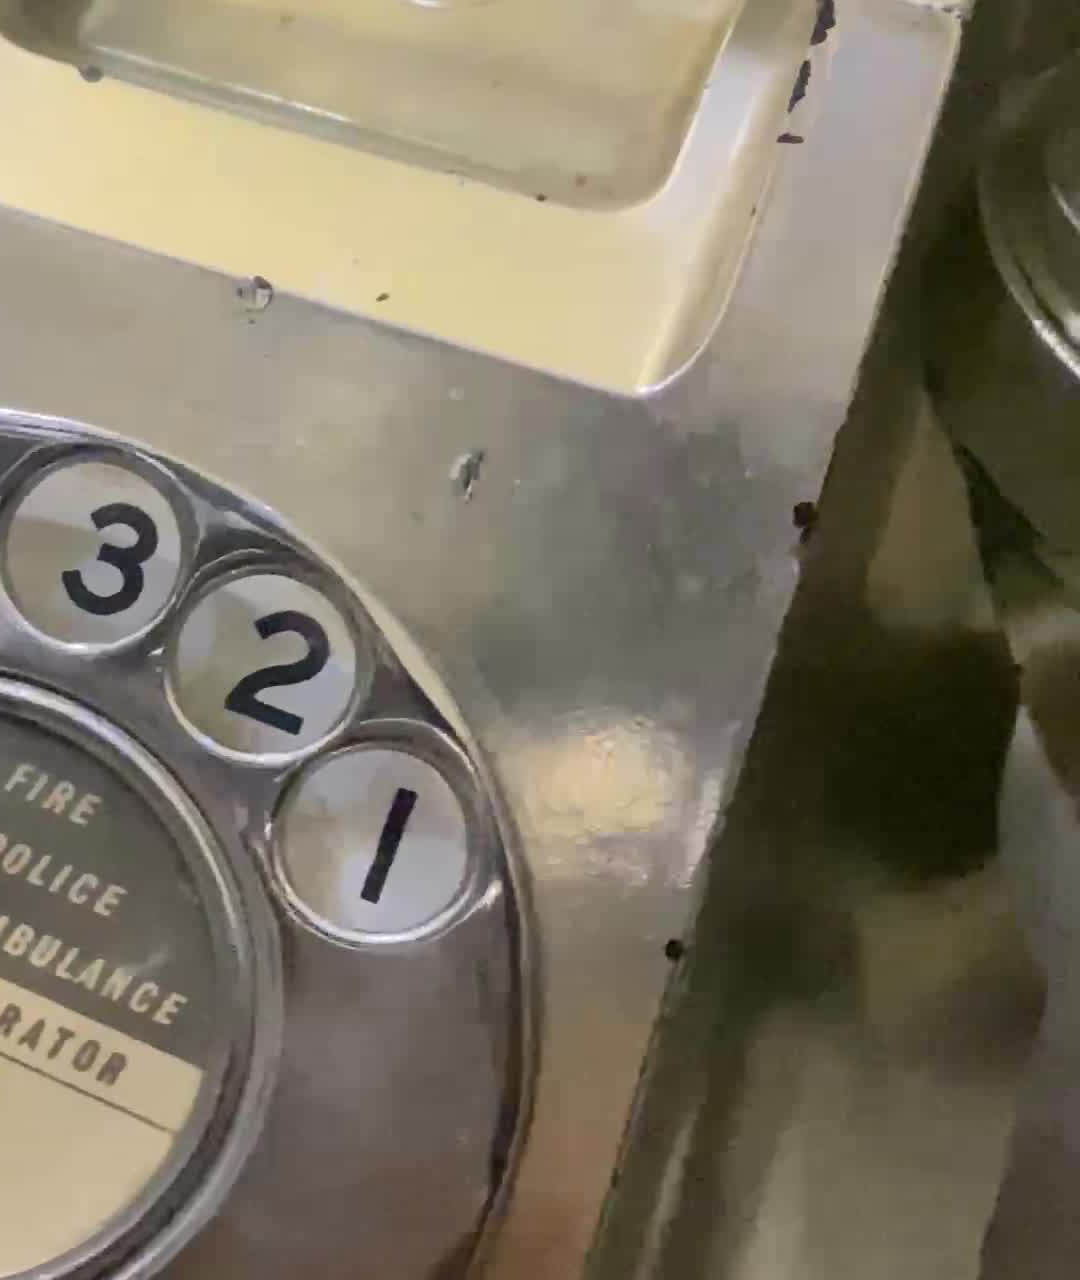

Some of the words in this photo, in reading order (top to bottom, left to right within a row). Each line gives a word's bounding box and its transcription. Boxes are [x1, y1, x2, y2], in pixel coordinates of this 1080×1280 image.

[60, 503, 160, 617] 3
[222, 610, 332, 736] 2
[4, 762, 102, 826] FIRE
[360, 787, 418, 905] 1
